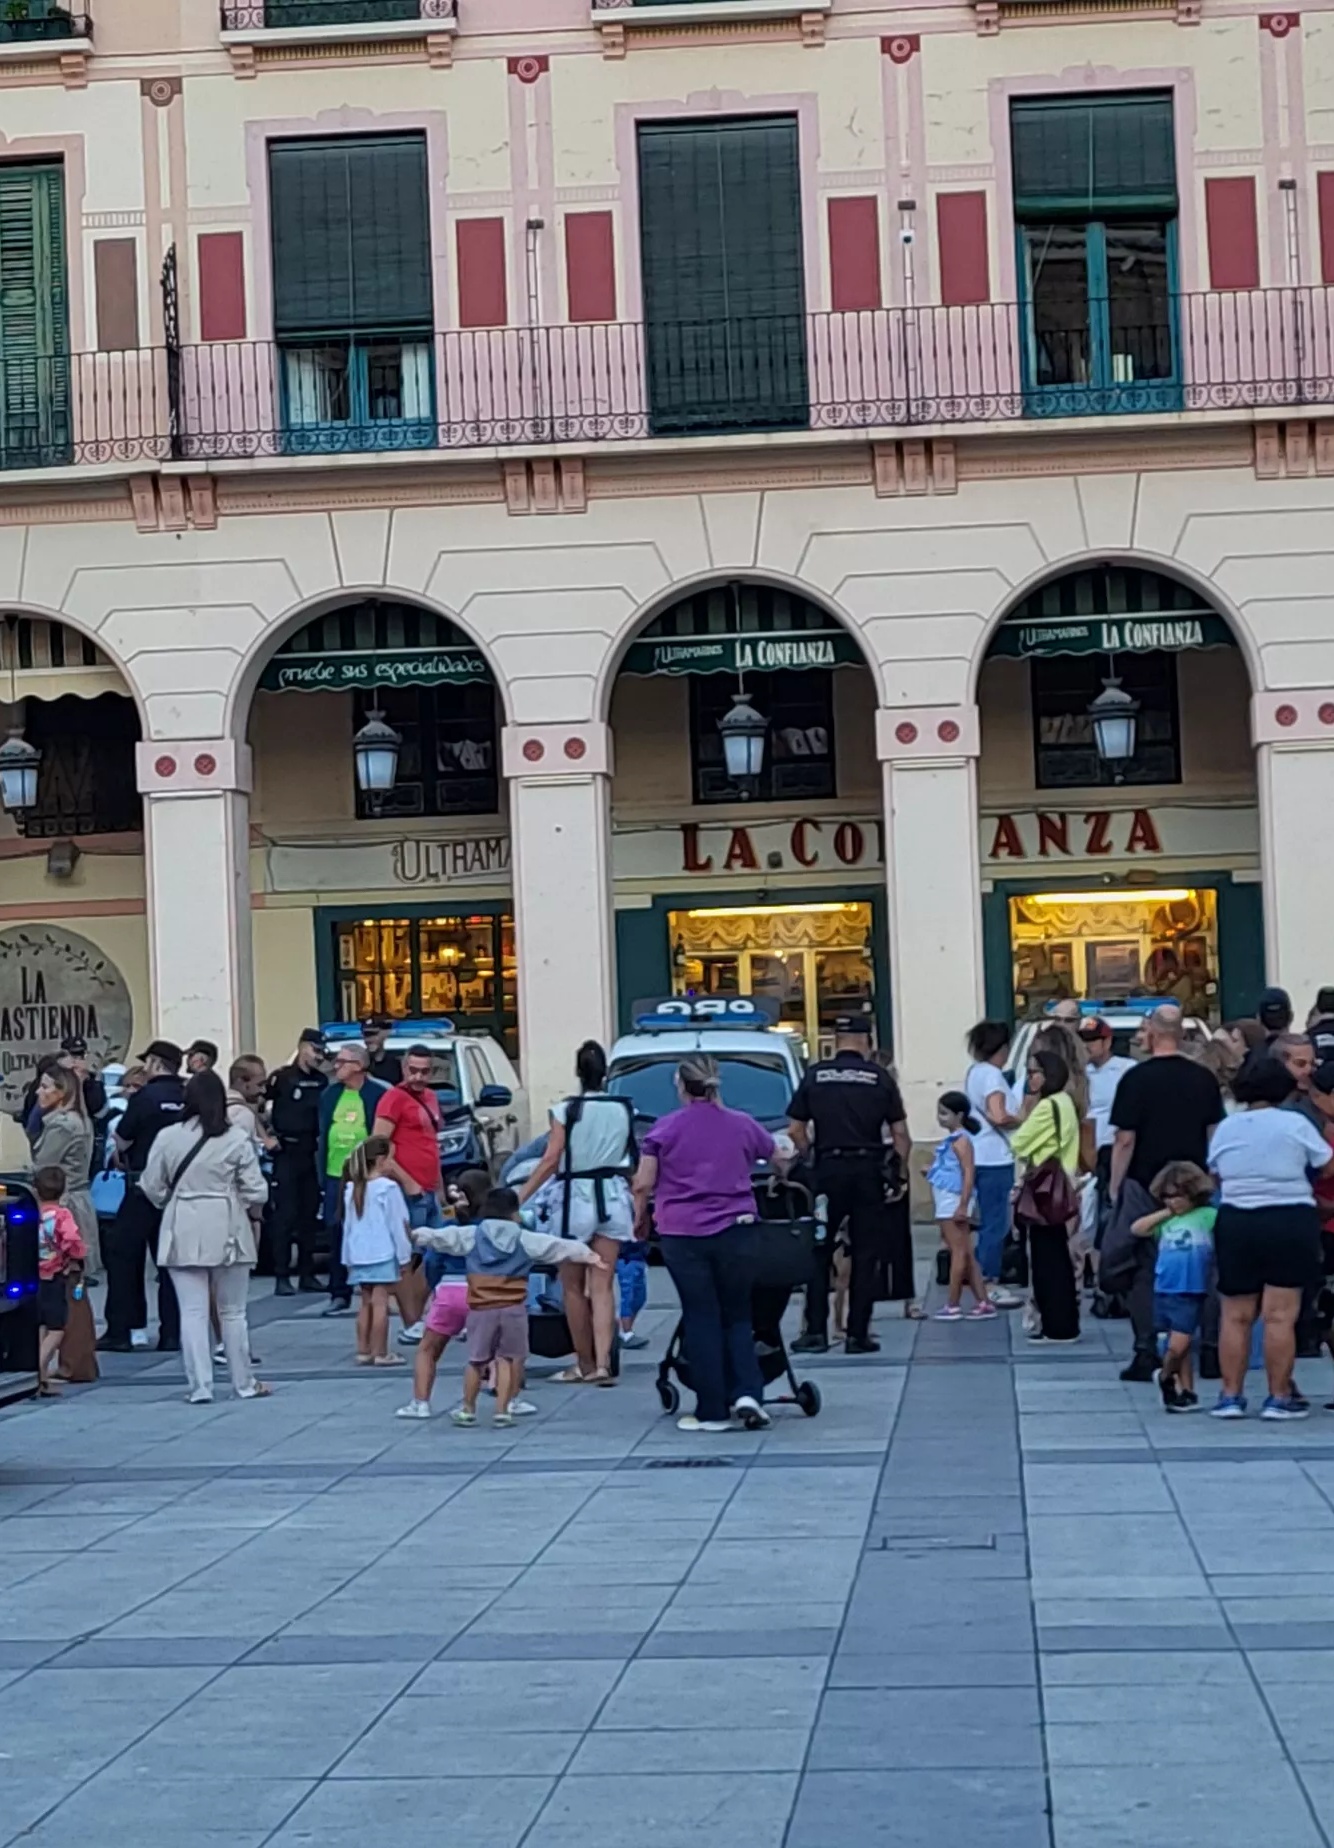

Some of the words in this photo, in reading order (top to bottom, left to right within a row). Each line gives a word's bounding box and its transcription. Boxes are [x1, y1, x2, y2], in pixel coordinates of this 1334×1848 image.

[1101, 622, 1120, 648] LA
[1123, 620, 1203, 648] CONFIANZA
[735, 640, 753, 667] LA
[757, 640, 835, 666] CONFIANZA
[340, 663, 368, 679] sus
[374, 655, 485, 682] especialidades
[682, 823, 760, 872] LA
[790, 818, 884, 867] CO
[21, 966, 46, 1004] LA
[2, 1051, 39, 1074] ULTRA
